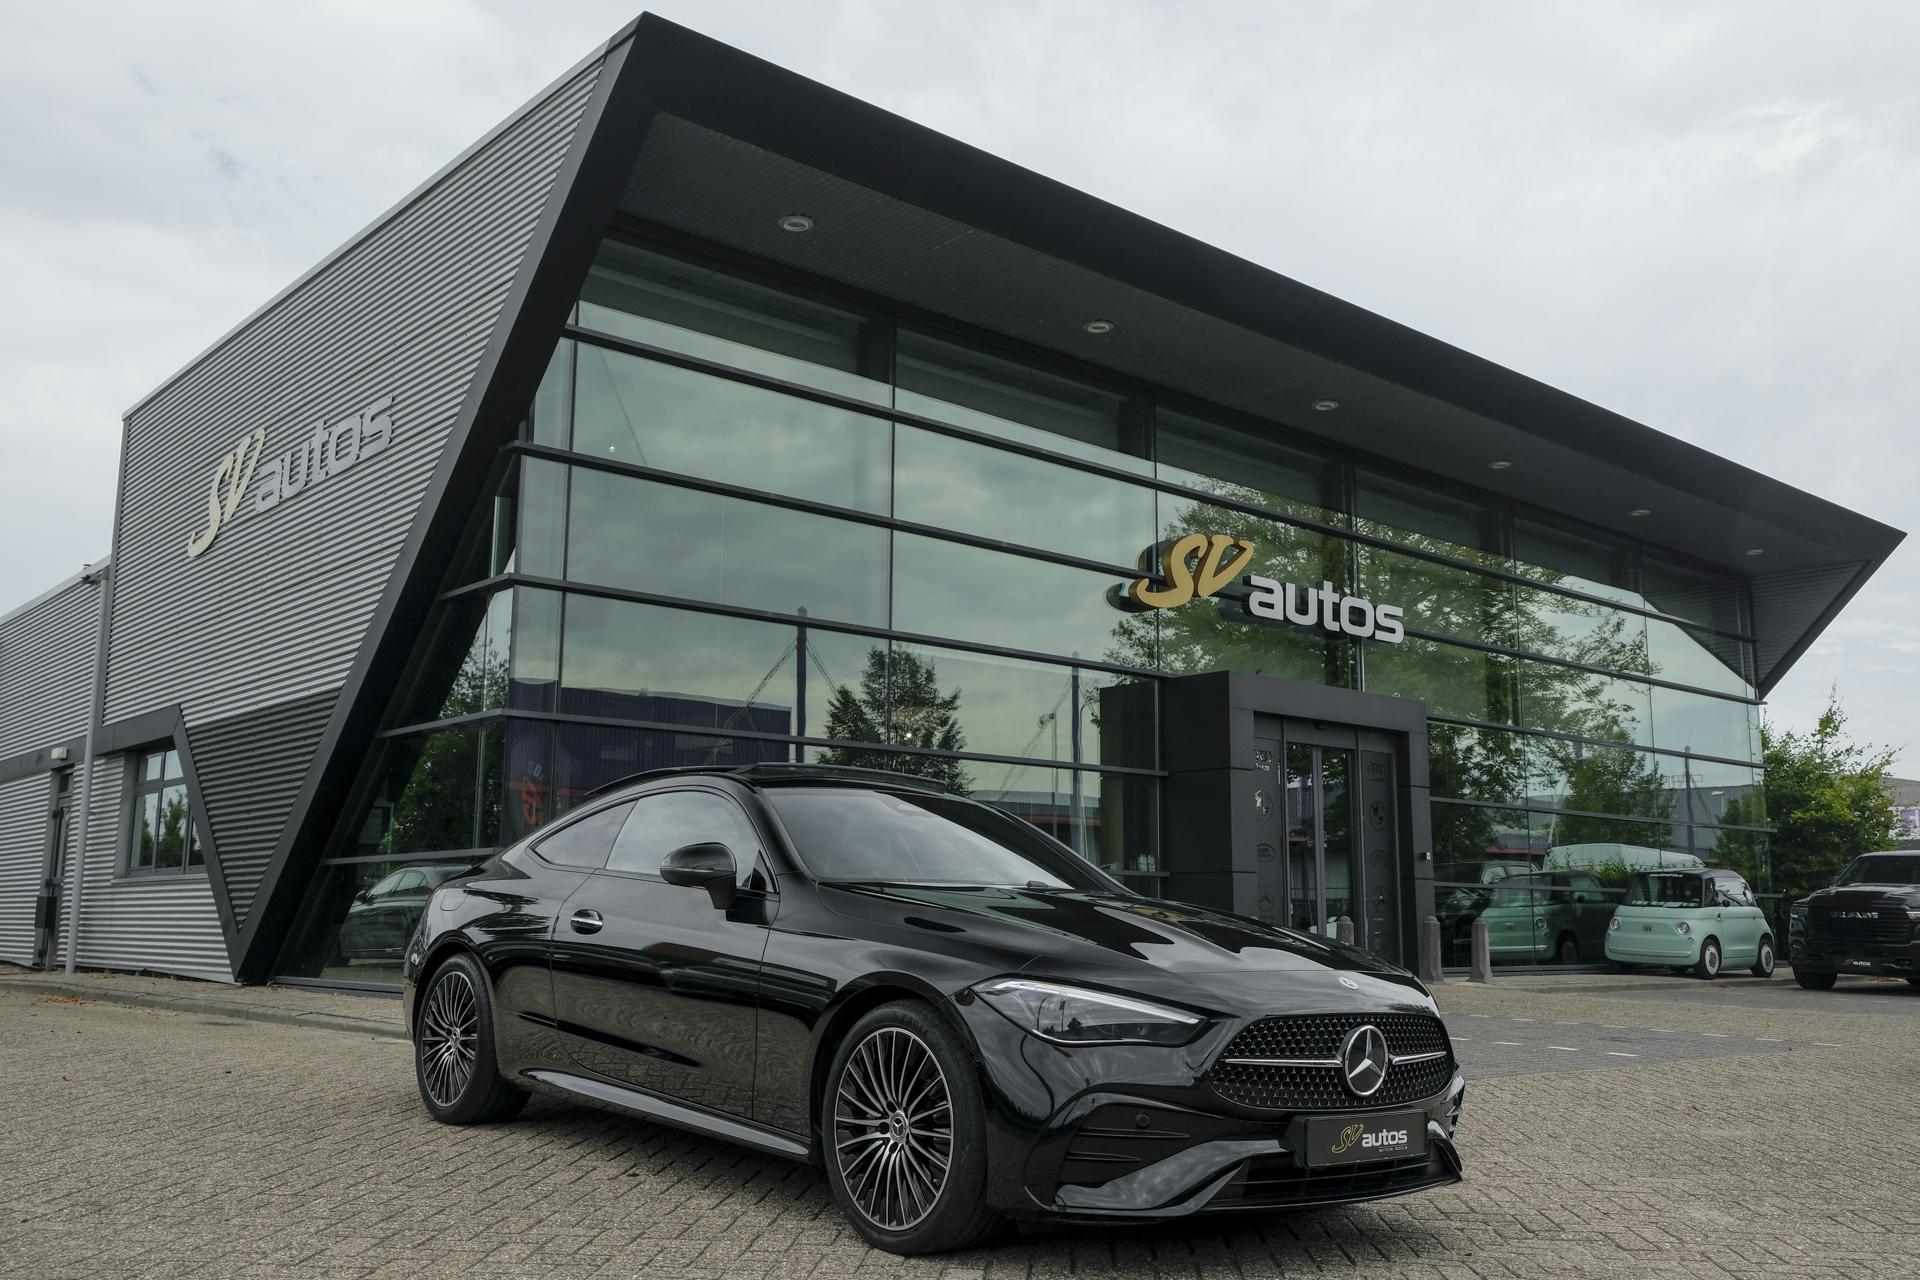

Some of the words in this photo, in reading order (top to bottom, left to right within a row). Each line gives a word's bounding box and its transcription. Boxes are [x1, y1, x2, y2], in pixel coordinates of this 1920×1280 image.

[187, 427, 265, 558] SV
[254, 393, 392, 513] autos
[1132, 533, 1255, 609] SV
[1246, 574, 1405, 644] autos
[1331, 1123, 1364, 1154] SV
[1361, 1128, 1408, 1148] autos
